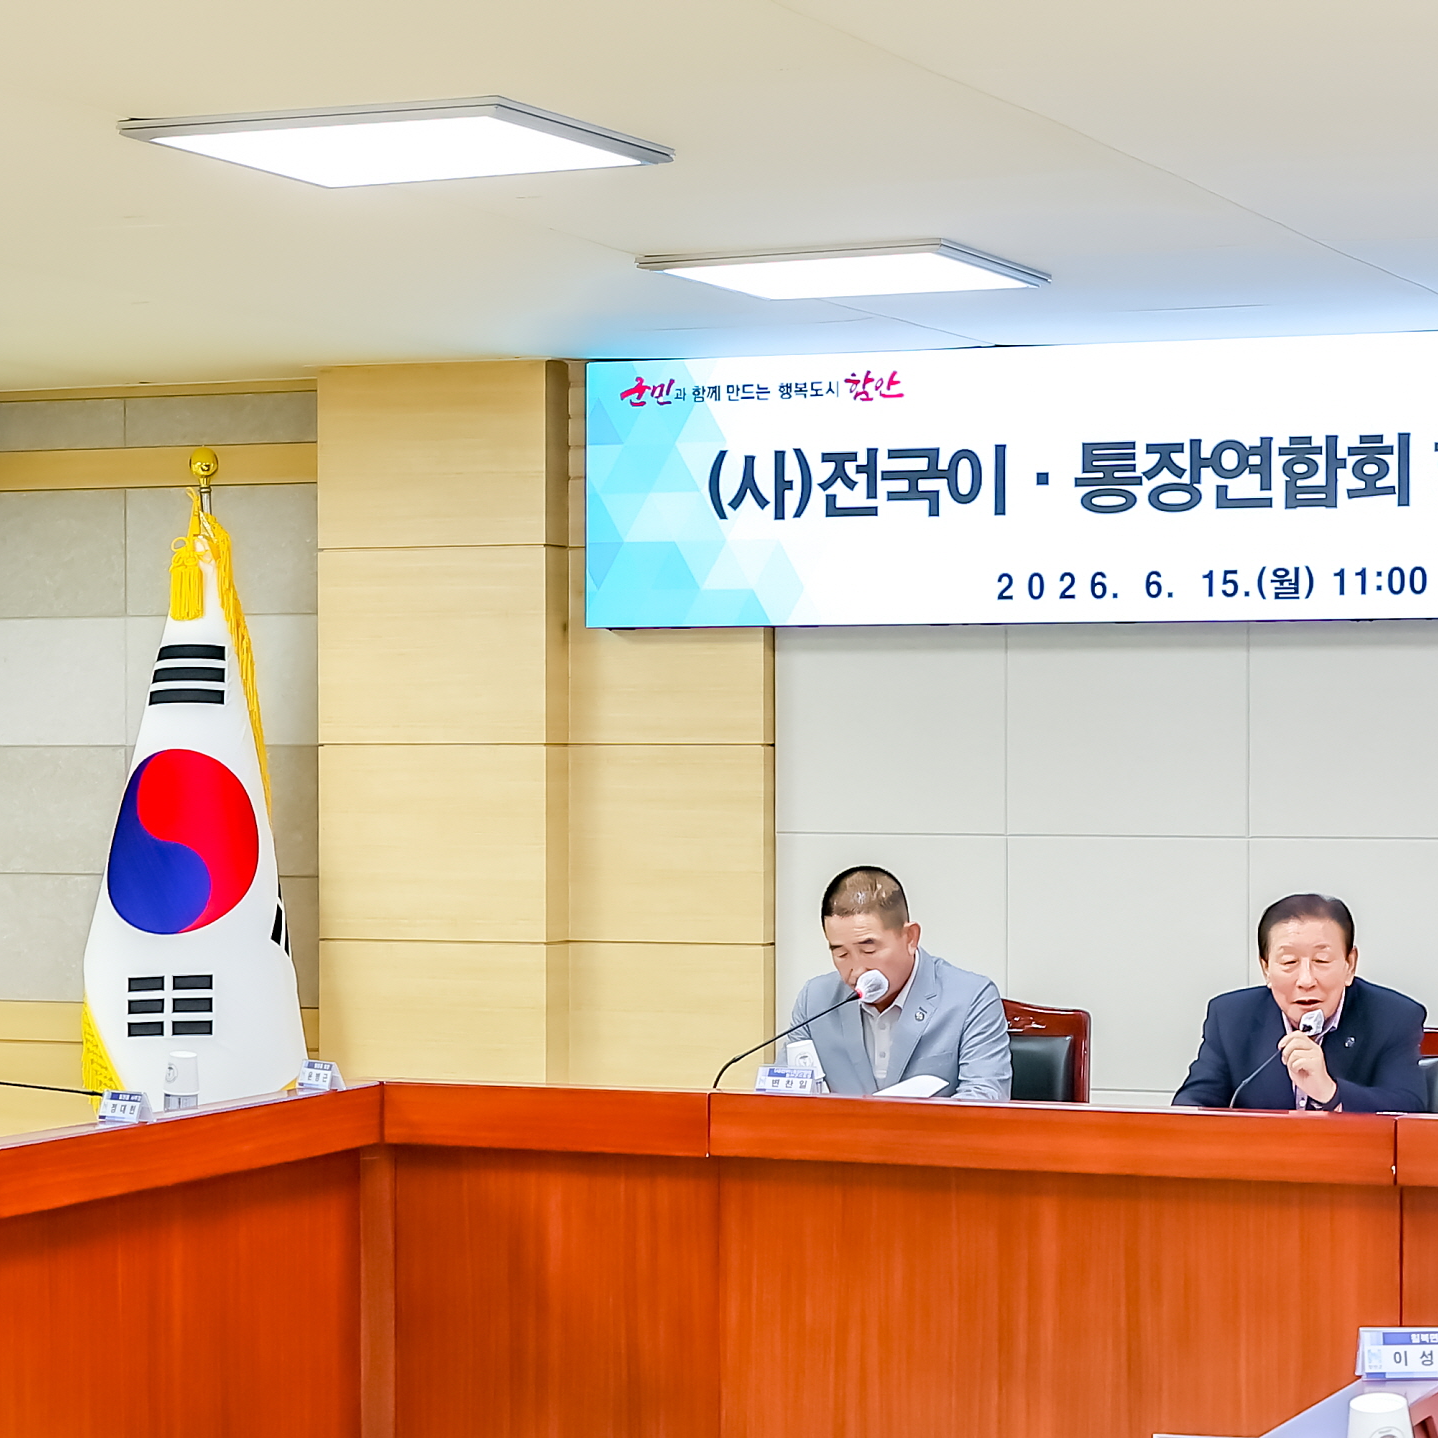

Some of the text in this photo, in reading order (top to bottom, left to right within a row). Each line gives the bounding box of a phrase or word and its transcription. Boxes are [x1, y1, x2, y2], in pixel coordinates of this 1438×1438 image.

[620, 370, 905, 406] 군민과 함께 만드는 행복도시 함안
[708, 442, 1008, 520] (사)전국이
[1074, 431, 1412, 514] 통장연합회
[1332, 565, 1428, 596] 11:00
